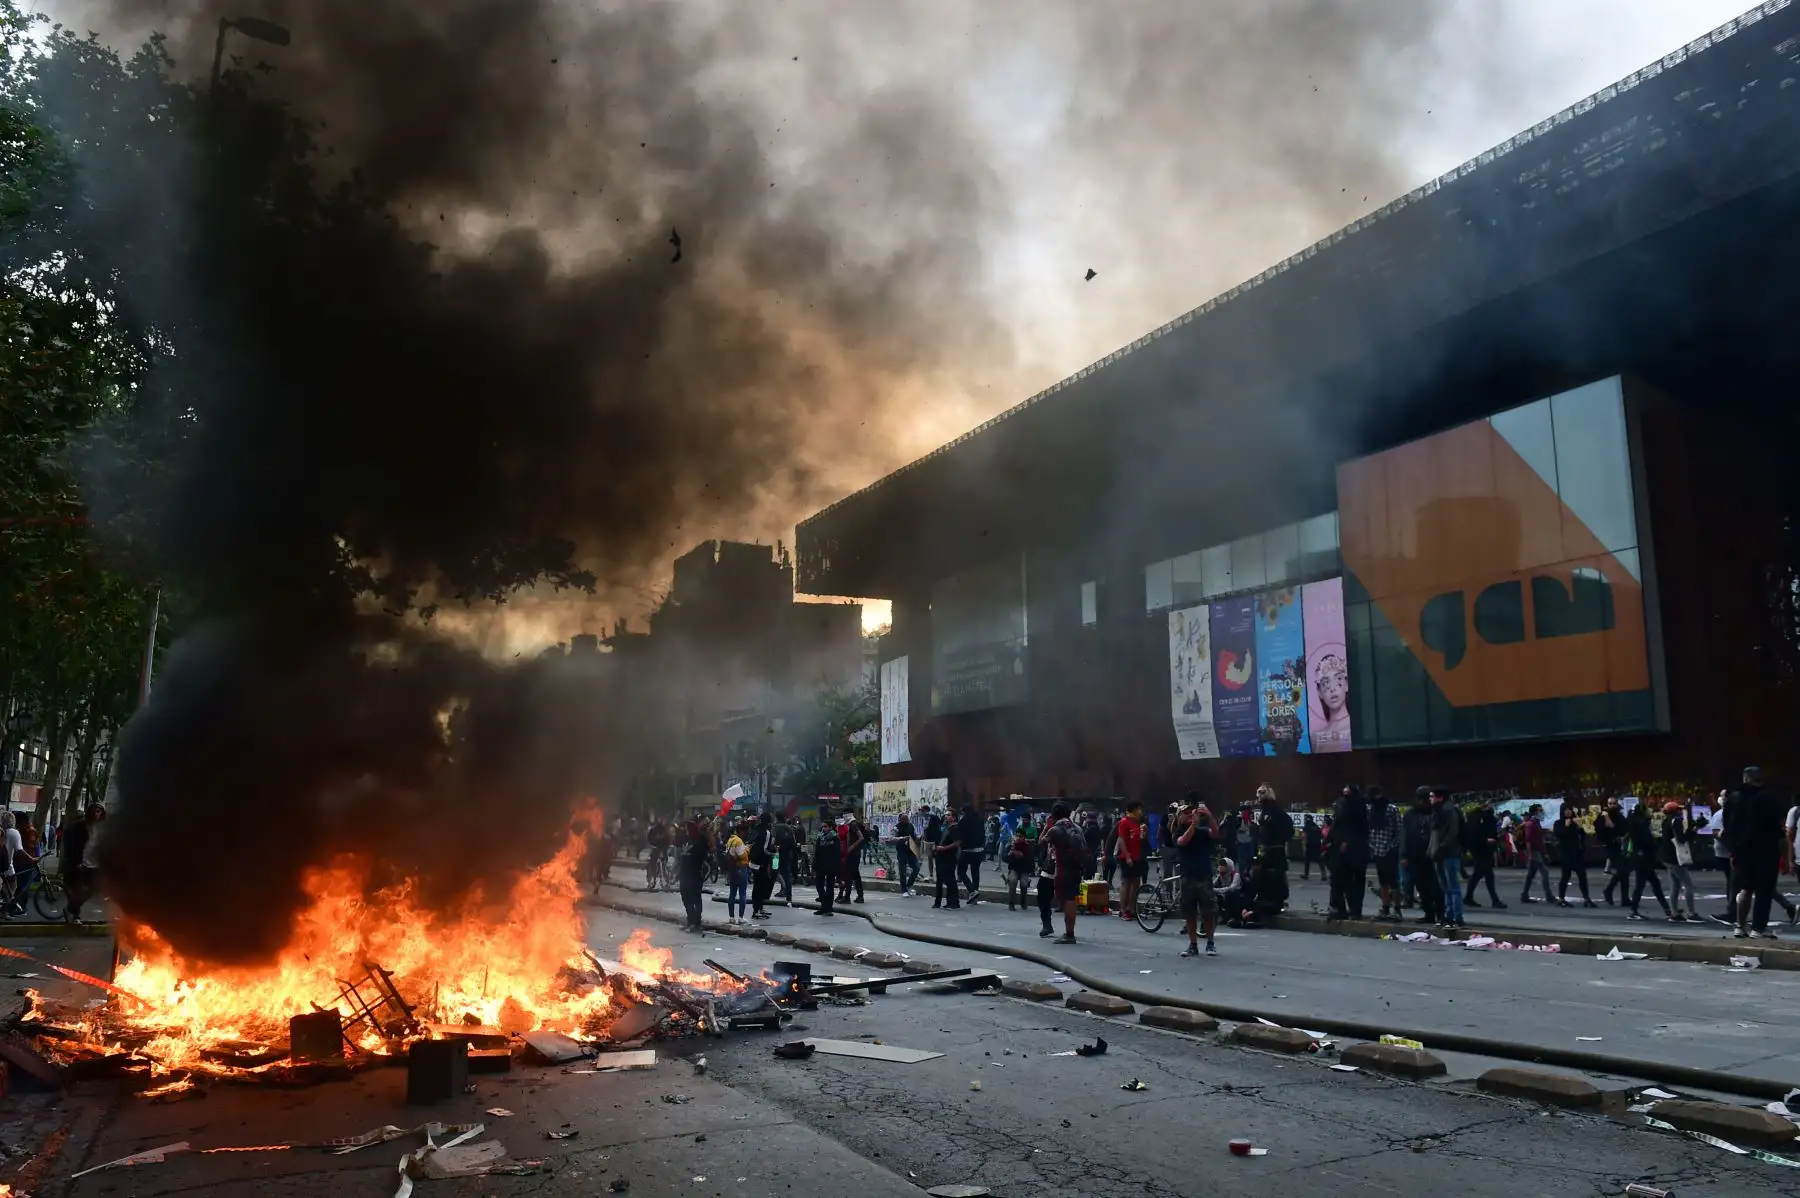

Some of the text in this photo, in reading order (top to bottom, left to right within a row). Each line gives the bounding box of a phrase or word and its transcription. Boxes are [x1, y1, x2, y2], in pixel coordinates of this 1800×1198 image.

[1260, 668, 1271, 679] LA
[1262, 691, 1292, 703] DE LAS
[1262, 705, 1296, 718] FLORES
